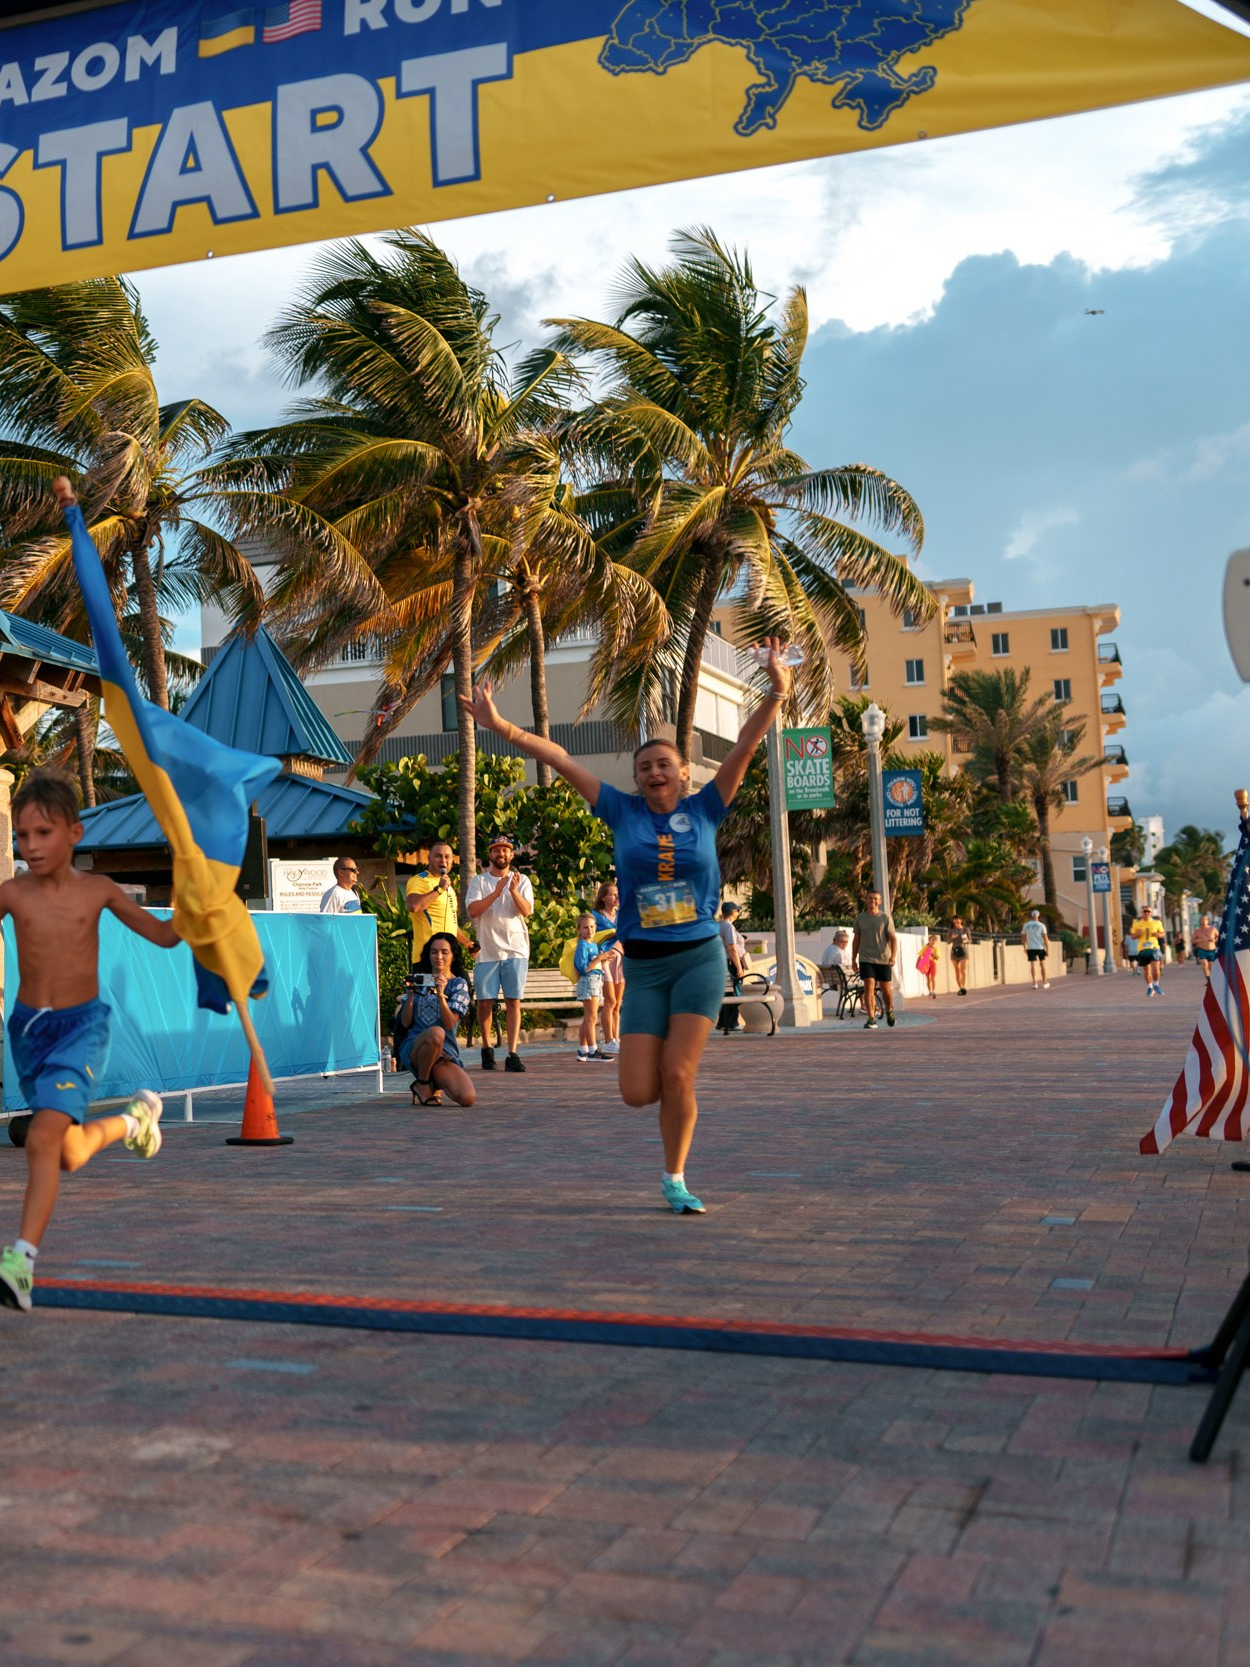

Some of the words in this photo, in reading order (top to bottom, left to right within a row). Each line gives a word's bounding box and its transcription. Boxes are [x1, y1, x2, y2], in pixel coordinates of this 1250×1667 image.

[786, 758, 830, 777] SKATE
[787, 774, 830, 789] BOARDS
[887, 776, 906, 788] THANK
[906, 777, 917, 787] YOU
[886, 808, 901, 818] FOR
[903, 808, 919, 817] NOT
[885, 817, 922, 827] LITTERING
